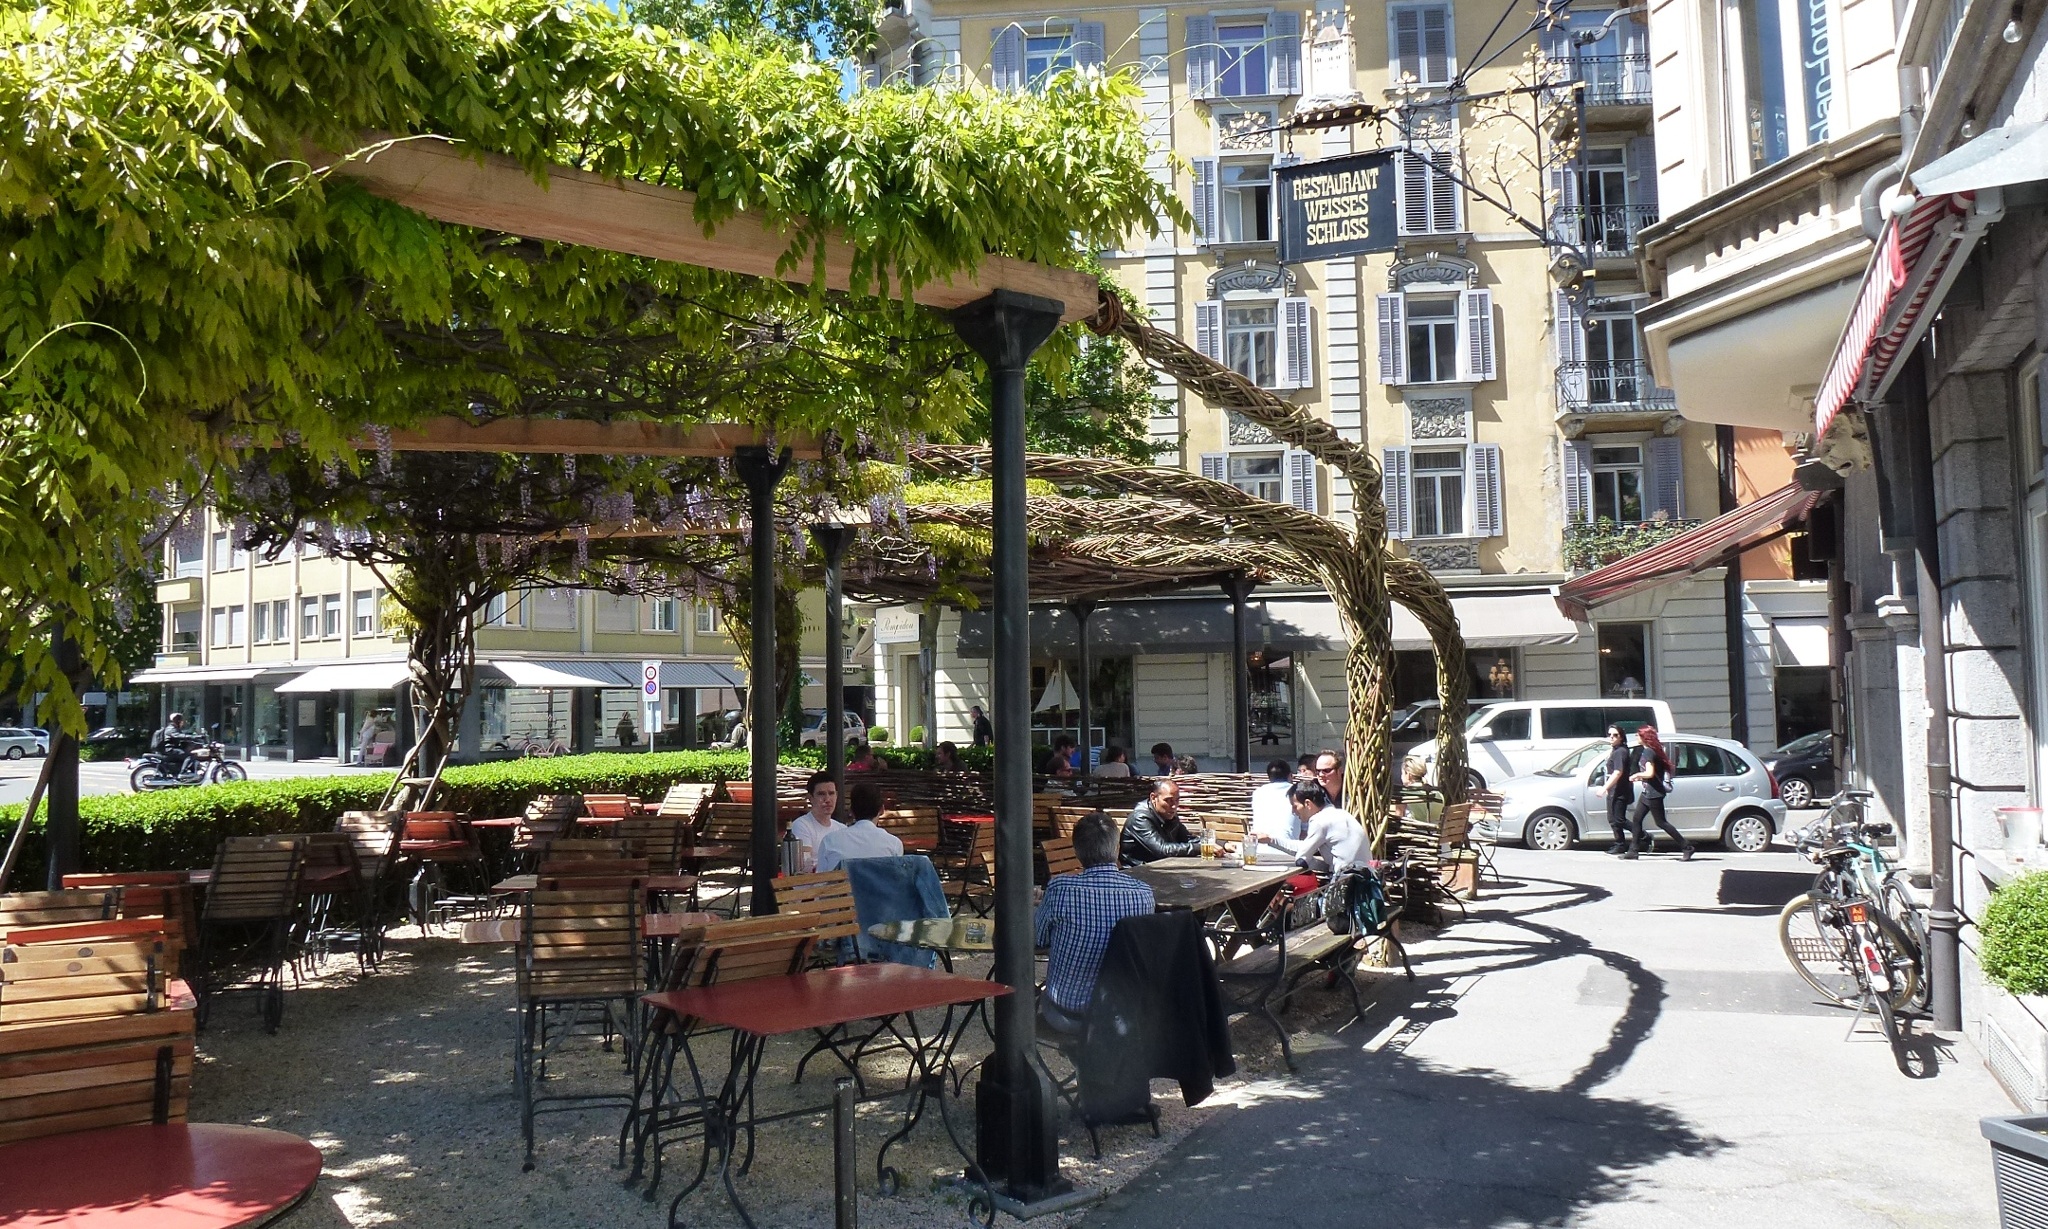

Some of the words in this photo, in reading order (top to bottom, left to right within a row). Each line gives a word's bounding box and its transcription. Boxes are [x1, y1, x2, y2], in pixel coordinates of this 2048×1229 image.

[1292, 167, 1379, 201] RESTAURANT
[1304, 193, 1369, 222] WEISSES
[1306, 217, 1369, 246] SCHLOSS
